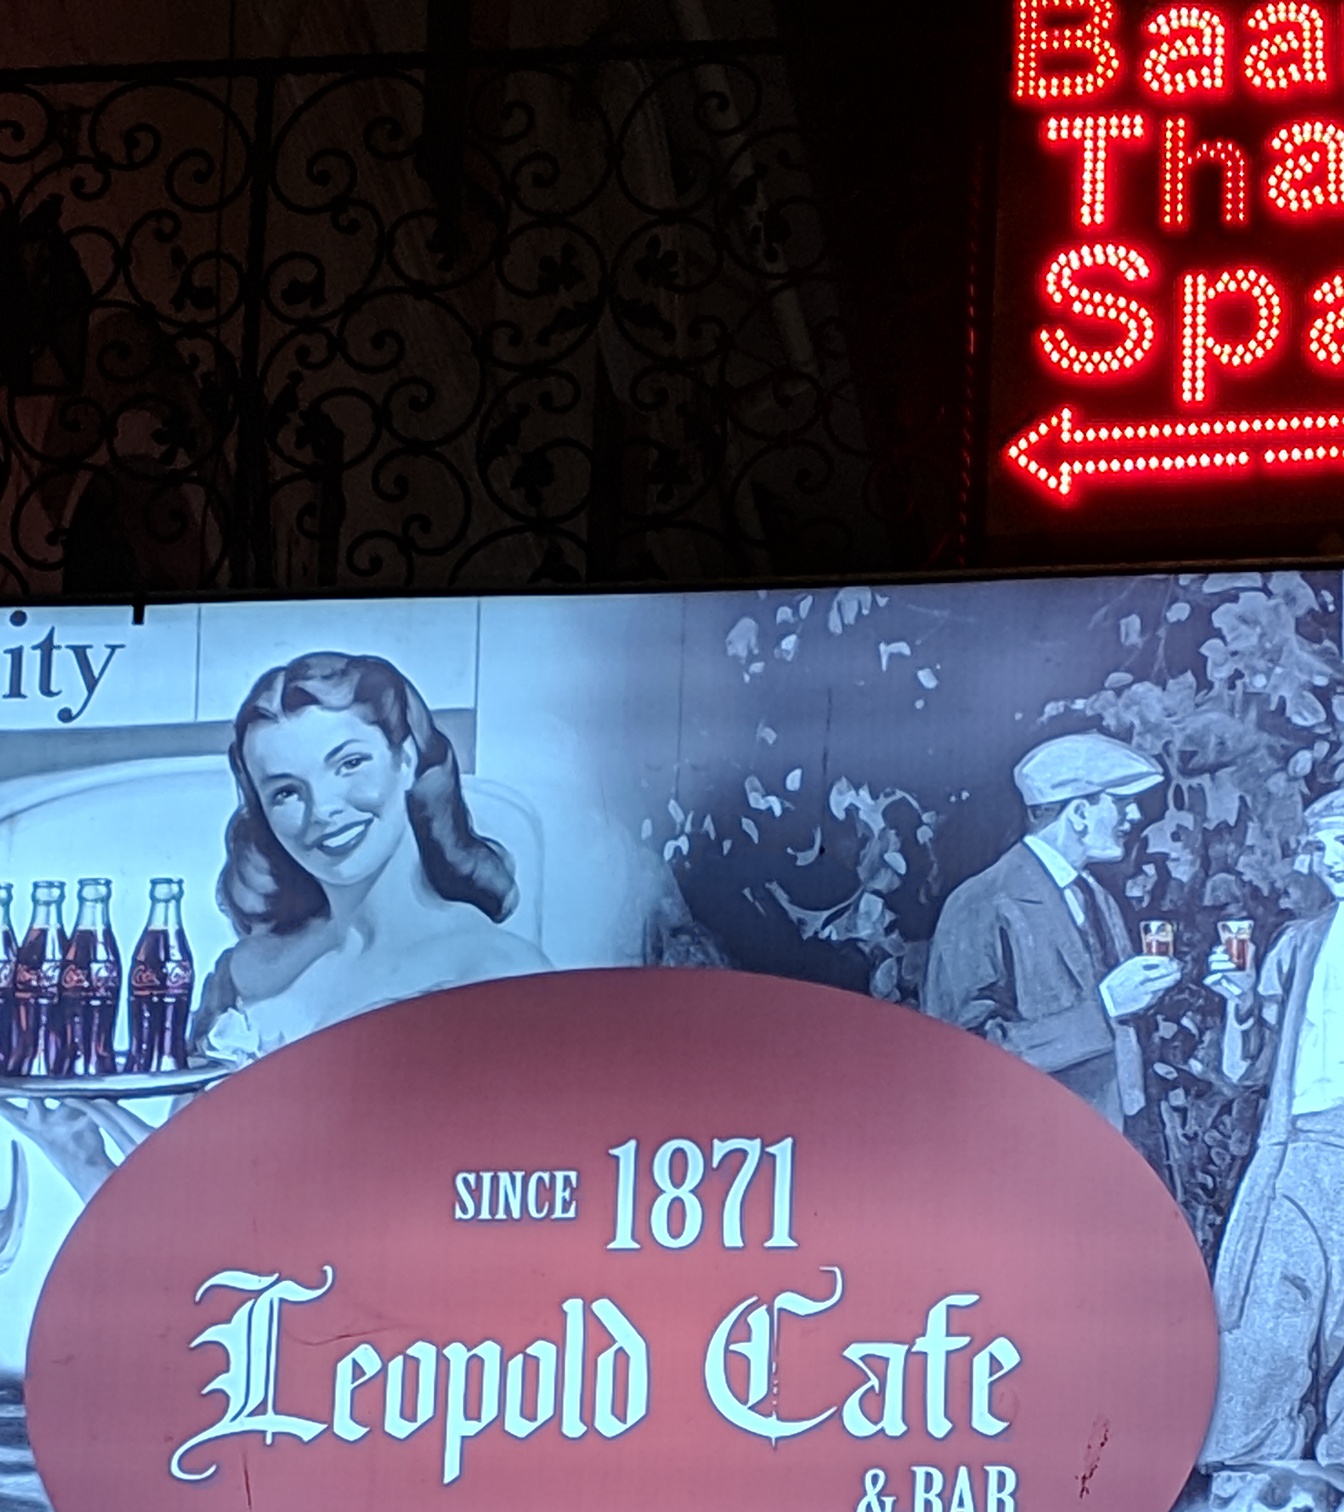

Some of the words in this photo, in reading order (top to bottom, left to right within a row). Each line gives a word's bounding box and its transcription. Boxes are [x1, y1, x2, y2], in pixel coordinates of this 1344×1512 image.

[454, 1169, 579, 1222] SINCE
[605, 1135, 799, 1251] 1871
[169, 1264, 651, 1486] Leopold
[704, 1264, 1022, 1449] Cafe
